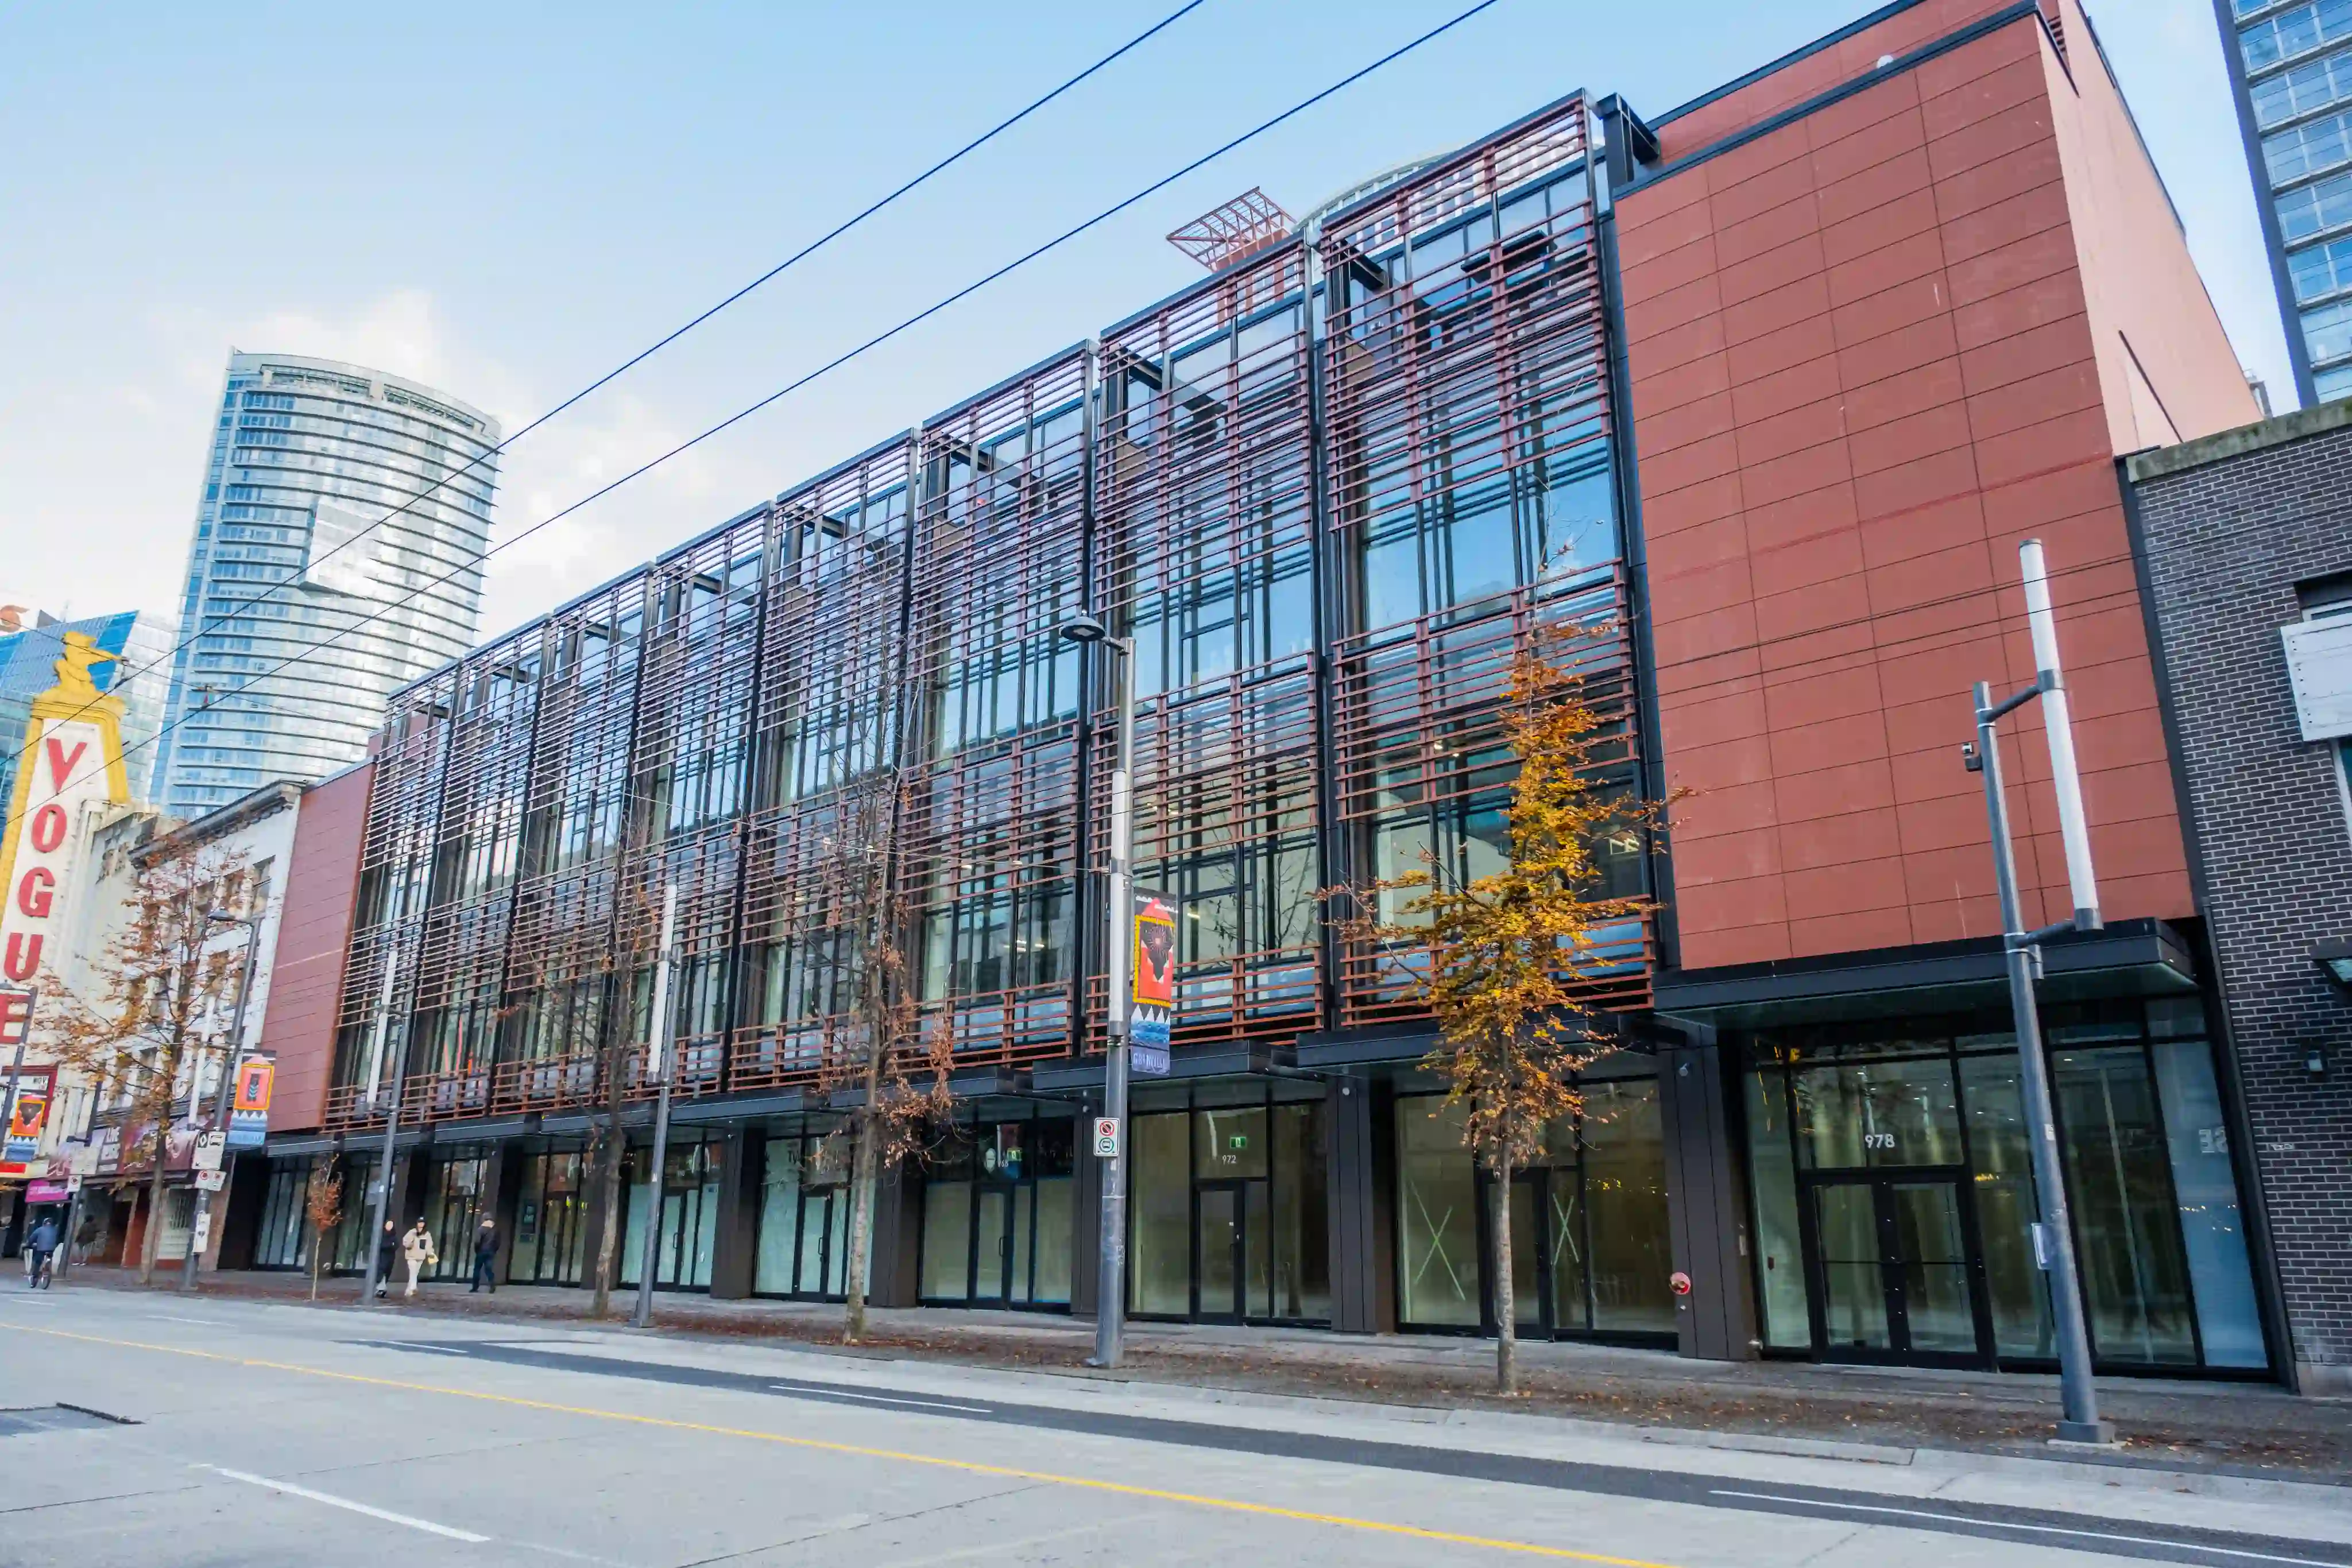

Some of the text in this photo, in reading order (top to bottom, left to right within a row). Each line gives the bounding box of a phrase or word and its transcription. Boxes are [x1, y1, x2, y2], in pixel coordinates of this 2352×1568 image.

[0, 738, 87, 1044] VOGUE
[1864, 1133, 1895, 1149] 978
[1222, 1155, 1236, 1166] 972
